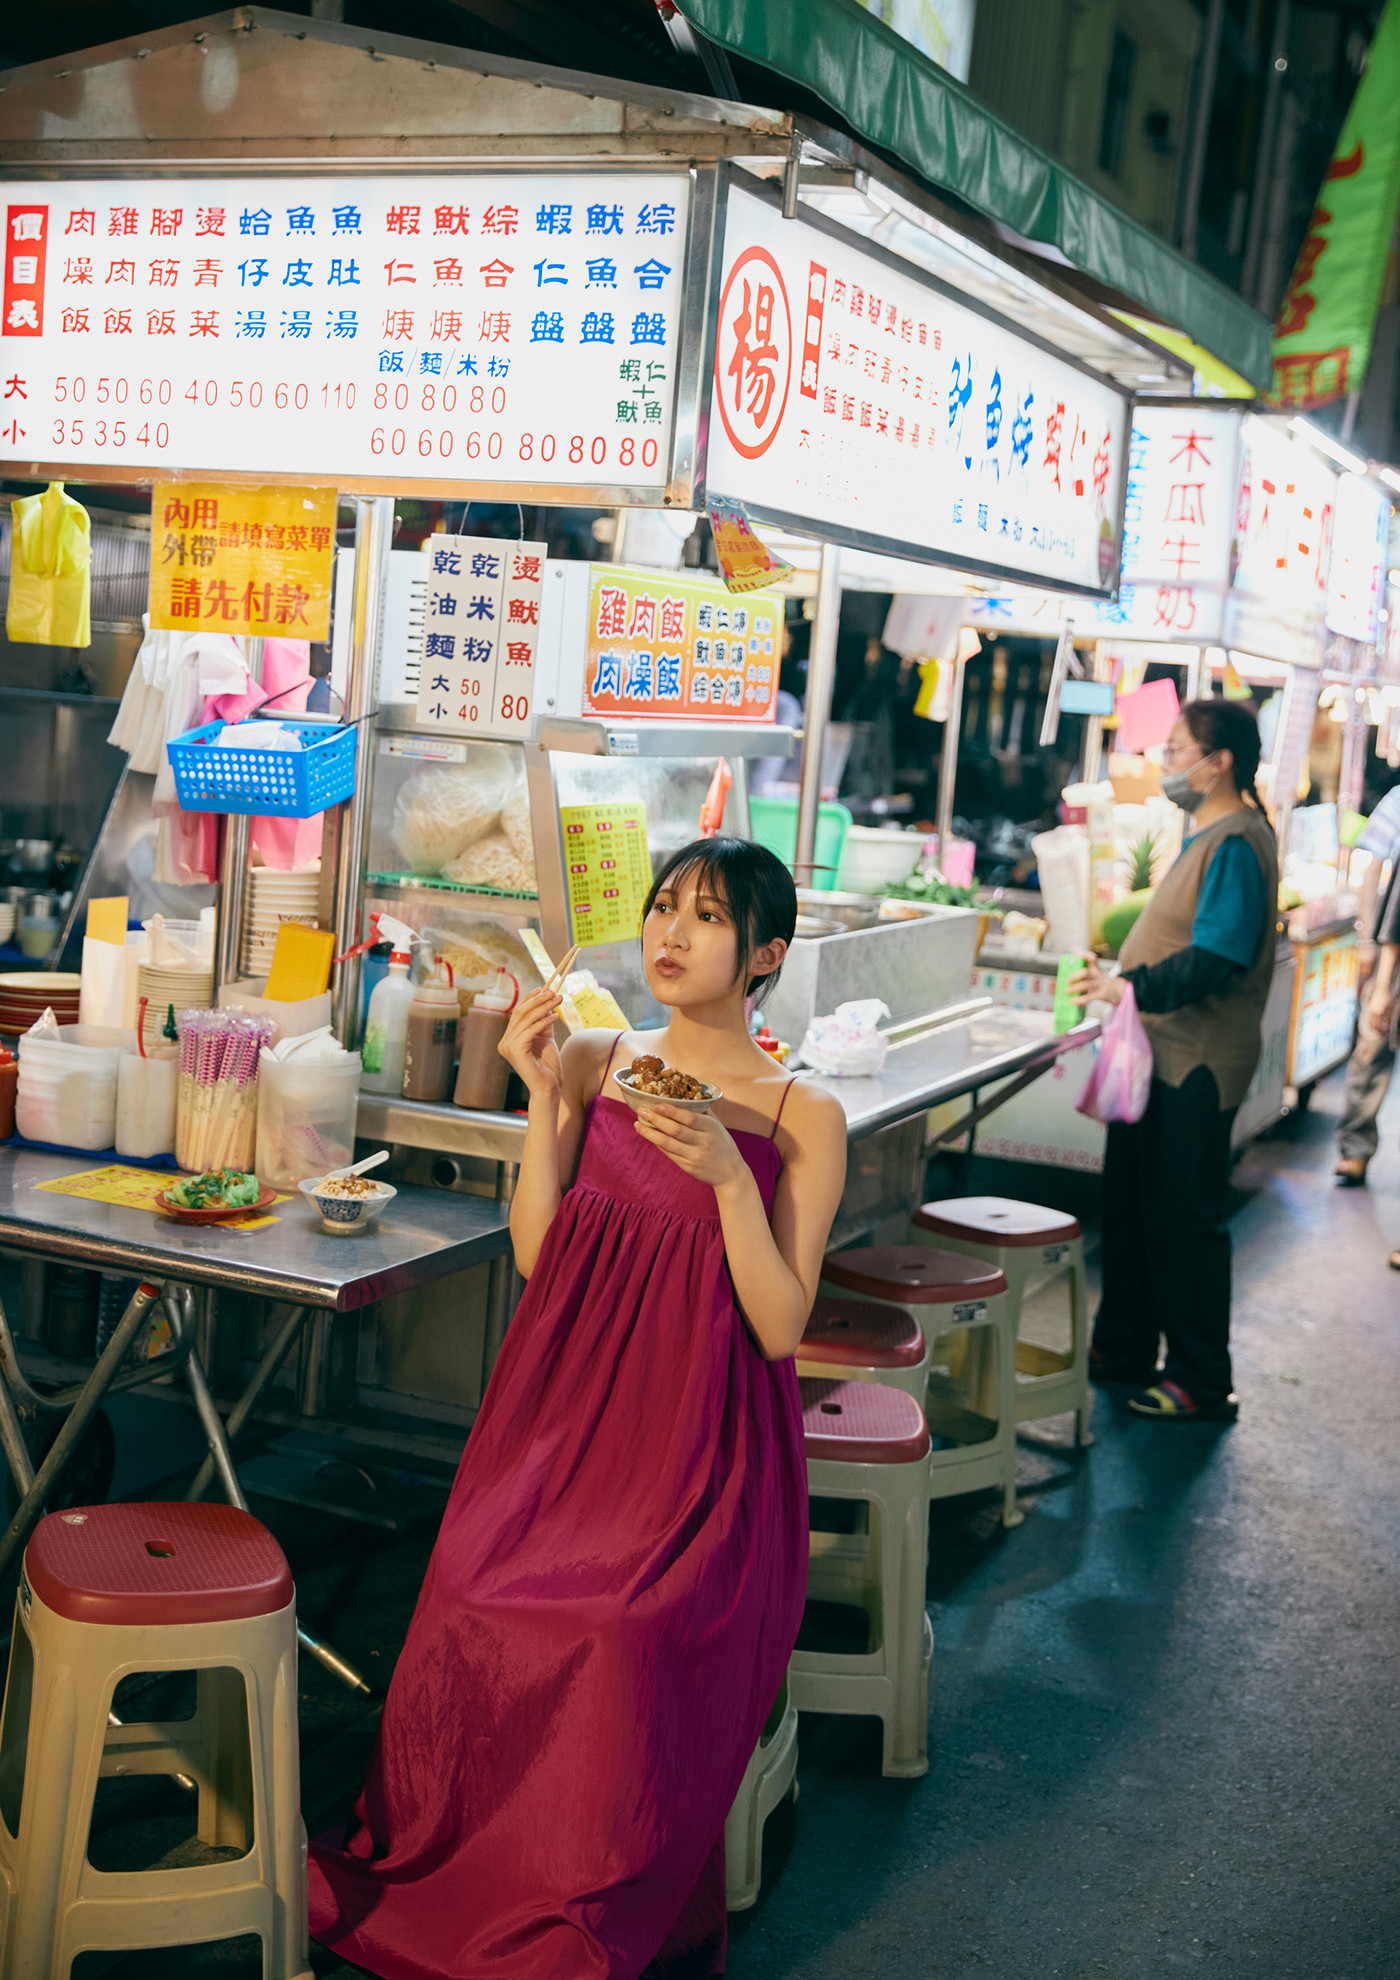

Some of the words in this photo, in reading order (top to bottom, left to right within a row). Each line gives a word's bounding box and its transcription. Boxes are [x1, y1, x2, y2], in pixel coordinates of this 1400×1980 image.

[7, 213, 44, 329] 價目表
[61, 208, 95, 333] 肉燥飯
[104, 207, 139, 334] 雞肉飯
[147, 208, 183, 335] 腳筋飯
[189, 208, 226, 338] 燙青菜
[235, 208, 272, 338] 蛤仔湯
[280, 206, 316, 338] 魚皮湯
[326, 205, 362, 339] 魚肚湯
[529, 204, 573, 343] 蝦仁盤
[579, 204, 624, 344] 魷魚盤
[630, 204, 675, 346] 綜合盤
[4, 373, 28, 400] 大
[54, 377, 86, 402] 50
[96, 378, 128, 403] 50
[140, 379, 171, 405] 60
[185, 380, 218, 406] 40
[230, 381, 263, 408] 50
[275, 382, 309, 409] 60
[321, 382, 356, 409] 110
[374, 383, 409, 410] 80
[421, 384, 457, 412] 80
[470, 386, 506, 414] 80
[620, 359, 666, 381] 蝦仁
[728, 277, 779, 430] 楊
[2, 419, 26, 445] 小
[52, 419, 84, 446] 35
[94, 420, 126, 447] 35
[136, 422, 169, 448] 40
[371, 428, 405, 455] 60
[418, 429, 453, 457] 60
[466, 431, 502, 459] 60
[519, 433, 556, 462] 80
[568, 435, 606, 464] 80
[619, 437, 658, 467] 80
[616, 400, 662, 424] 魷魚
[162, 533, 218, 566] 外帶
[219, 522, 331, 552] 請填寫菜單
[1153, 430, 1214, 630] 木瓜牛奶
[171, 577, 309, 625] 請先付款
[426, 550, 462, 660] 乾油麵
[463, 553, 500, 663] 乾米粉
[505, 555, 542, 667] 燙魷魚
[597, 588, 687, 641] 雞肉飯
[429, 703, 447, 718] 小
[459, 704, 478, 721] 40
[431, 675, 449, 692] 大
[461, 679, 480, 696] 50
[501, 694, 528, 720] 80
[593, 651, 681, 698] 肉燥飯
